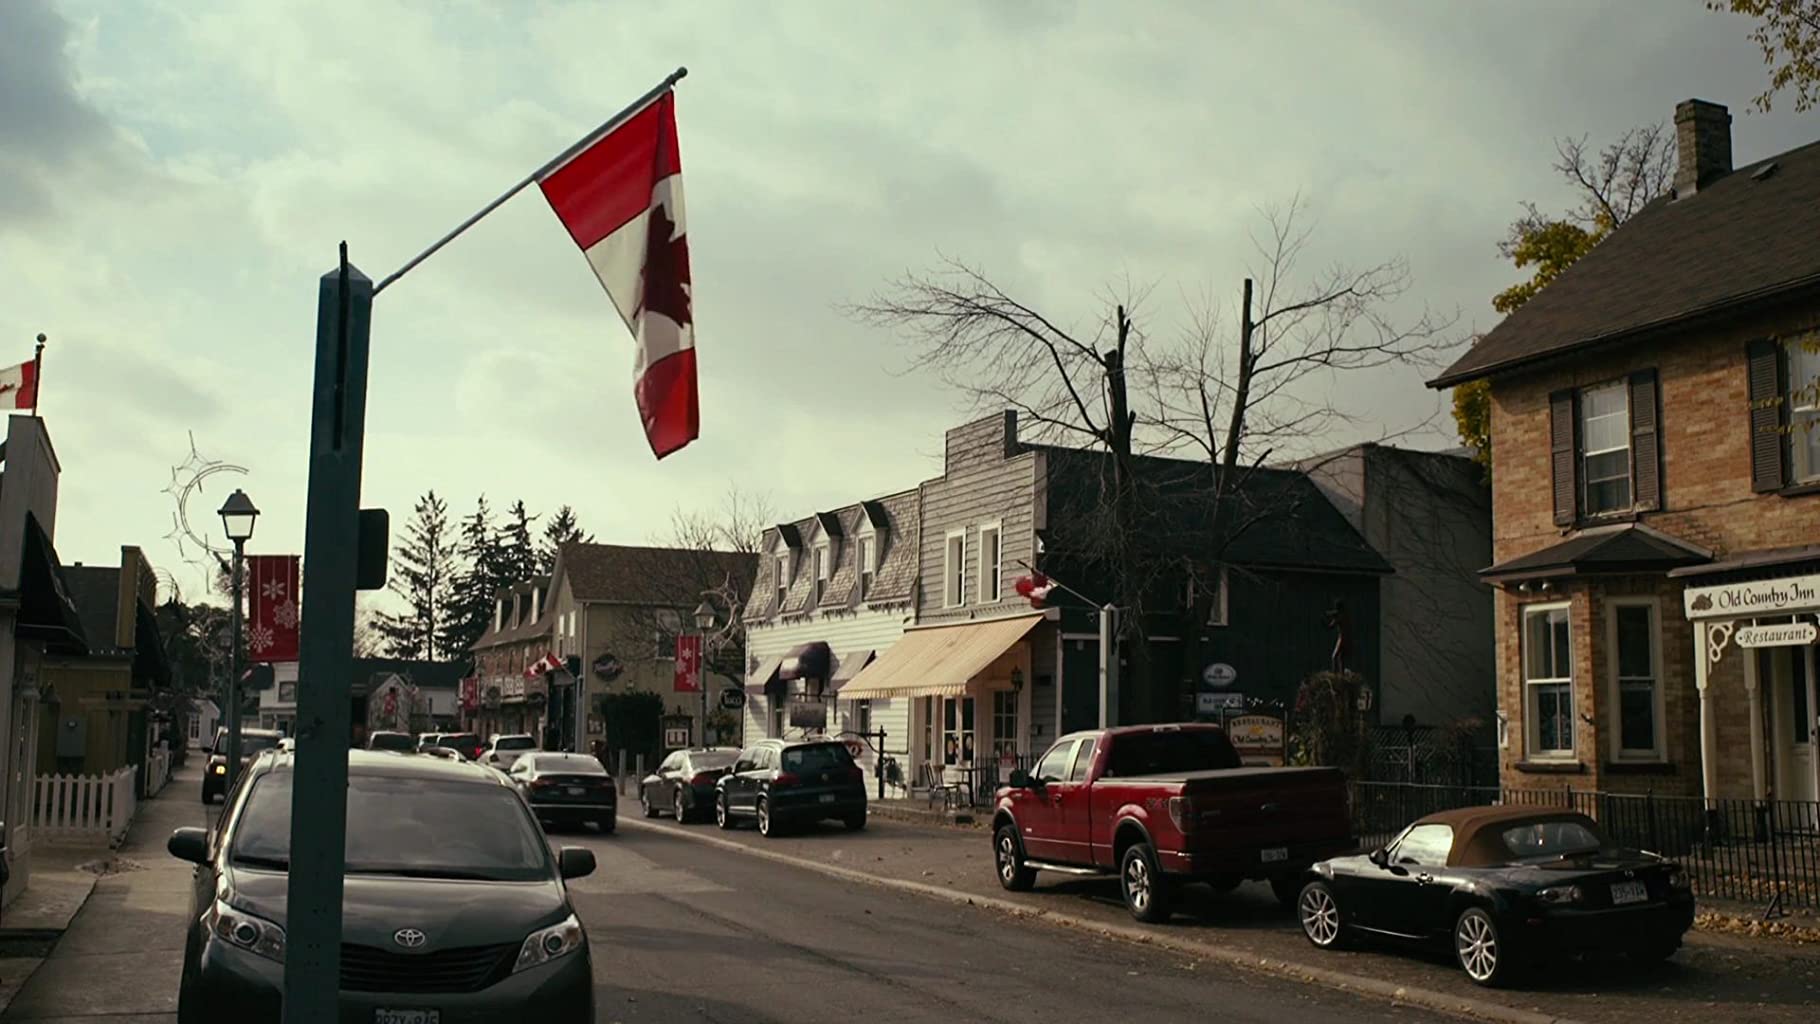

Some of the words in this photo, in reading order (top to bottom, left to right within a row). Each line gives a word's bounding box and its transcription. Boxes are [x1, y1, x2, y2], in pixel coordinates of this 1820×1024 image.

[1719, 590, 1741, 608] Old
[1743, 586, 1788, 607] Country
[1790, 583, 1815, 602] Inn
[1744, 628, 1807, 645] Restaurant
